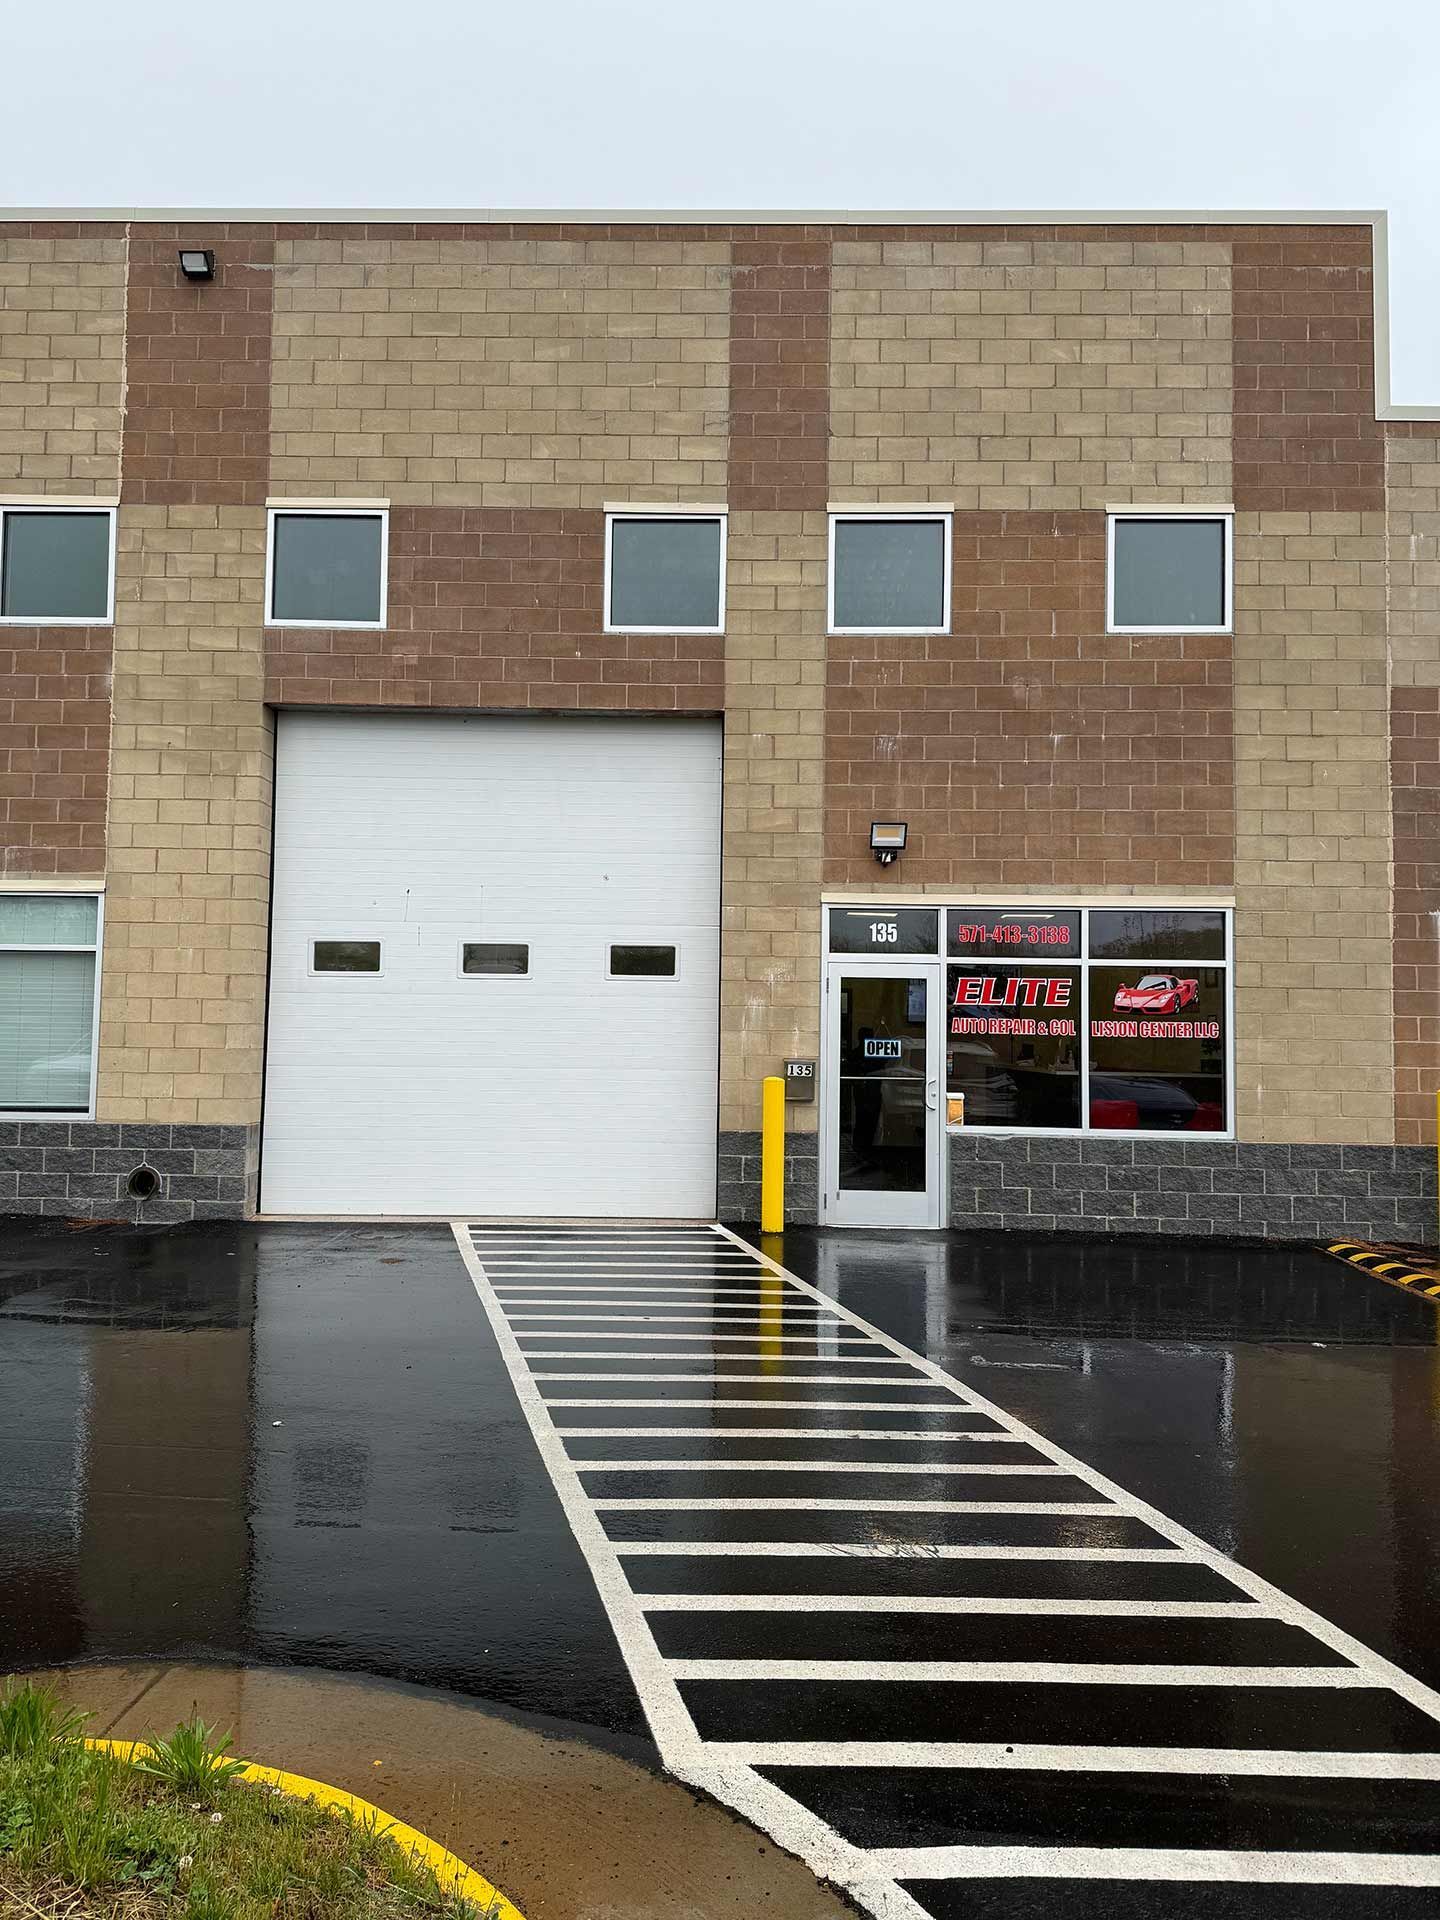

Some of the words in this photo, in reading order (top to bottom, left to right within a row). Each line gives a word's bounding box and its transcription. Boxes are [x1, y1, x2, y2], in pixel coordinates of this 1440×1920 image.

[869, 922, 898, 943] 135
[958, 924, 1070, 944] 571-413-3138
[953, 976, 1073, 1007] ELITE
[951, 1017, 988, 1034] AUTO
[988, 1018, 1036, 1035] REPAIR
[1037, 1021, 1049, 1036] &
[1049, 1019, 1077, 1036] COL
[1091, 1020, 1138, 1038] LISION
[1140, 1021, 1193, 1038] CENTER
[1194, 1021, 1220, 1039] LLC
[866, 1040, 900, 1056] OPEN
[789, 1064, 812, 1076] 135
